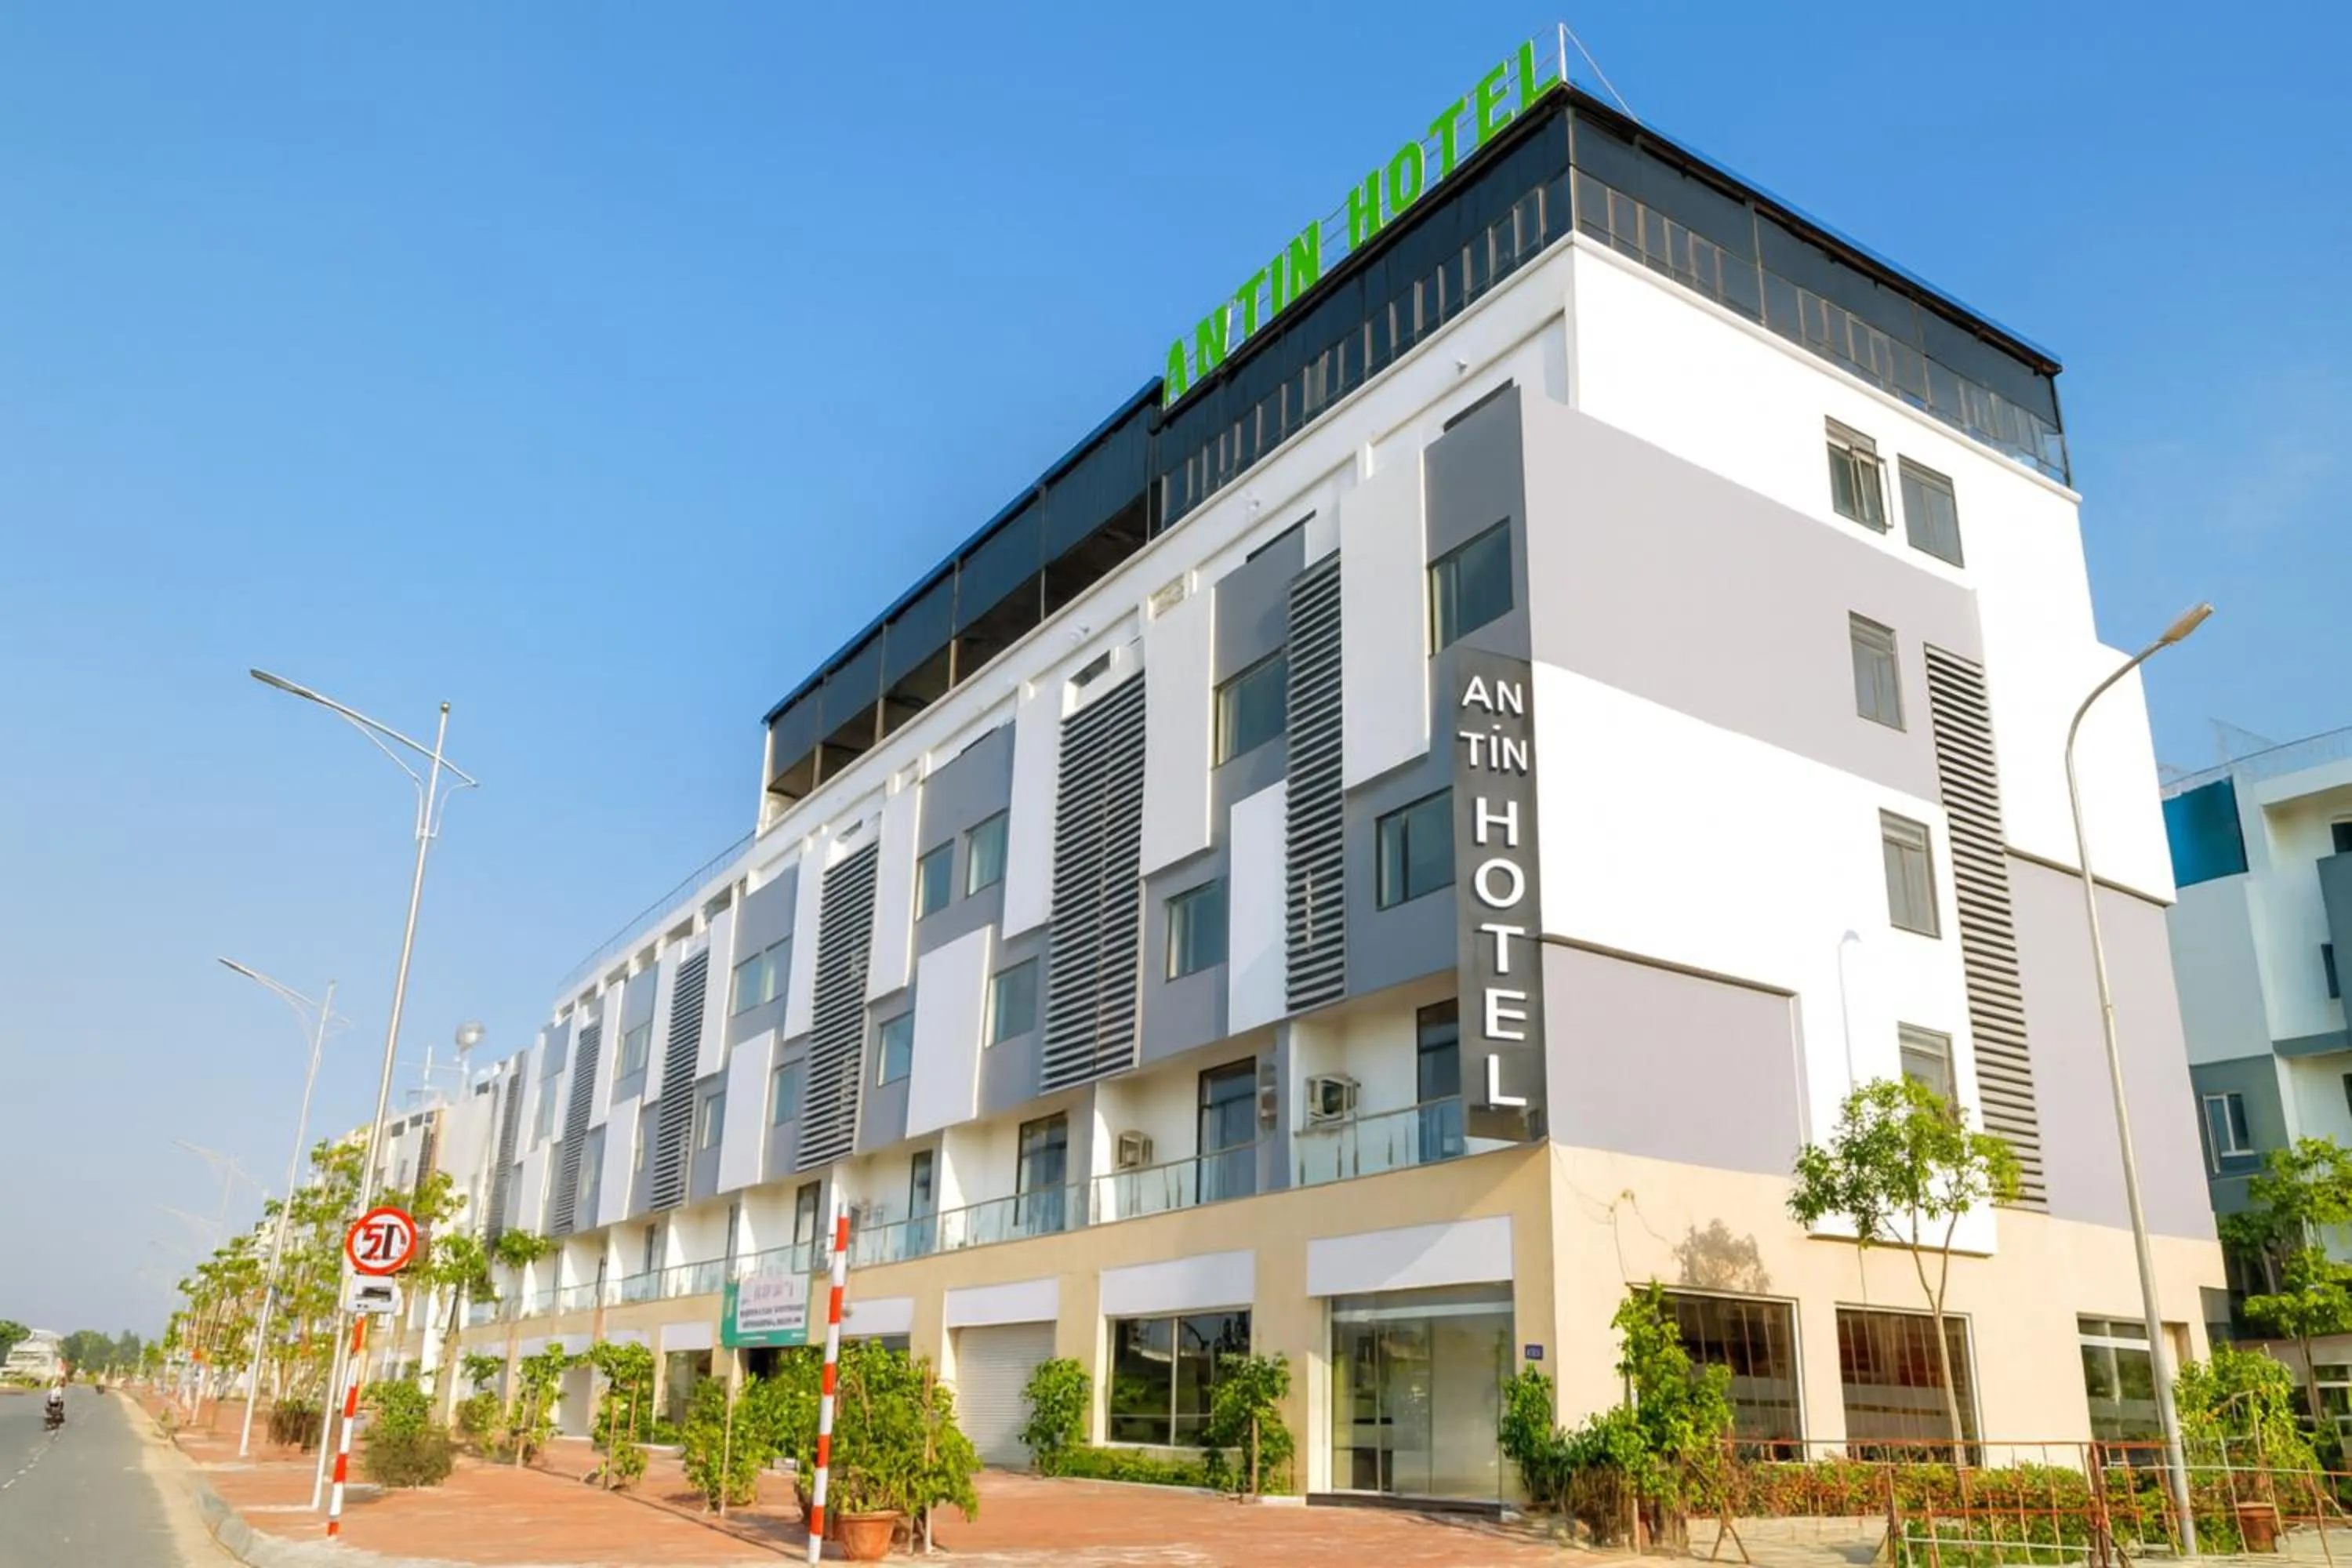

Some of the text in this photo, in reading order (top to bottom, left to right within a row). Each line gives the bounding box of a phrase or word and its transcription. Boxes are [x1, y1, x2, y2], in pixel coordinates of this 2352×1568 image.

[1348, 40, 1559, 250] HOTEL
[1462, 676, 1523, 714] AN
[1475, 797, 1527, 1106] HOTEL
